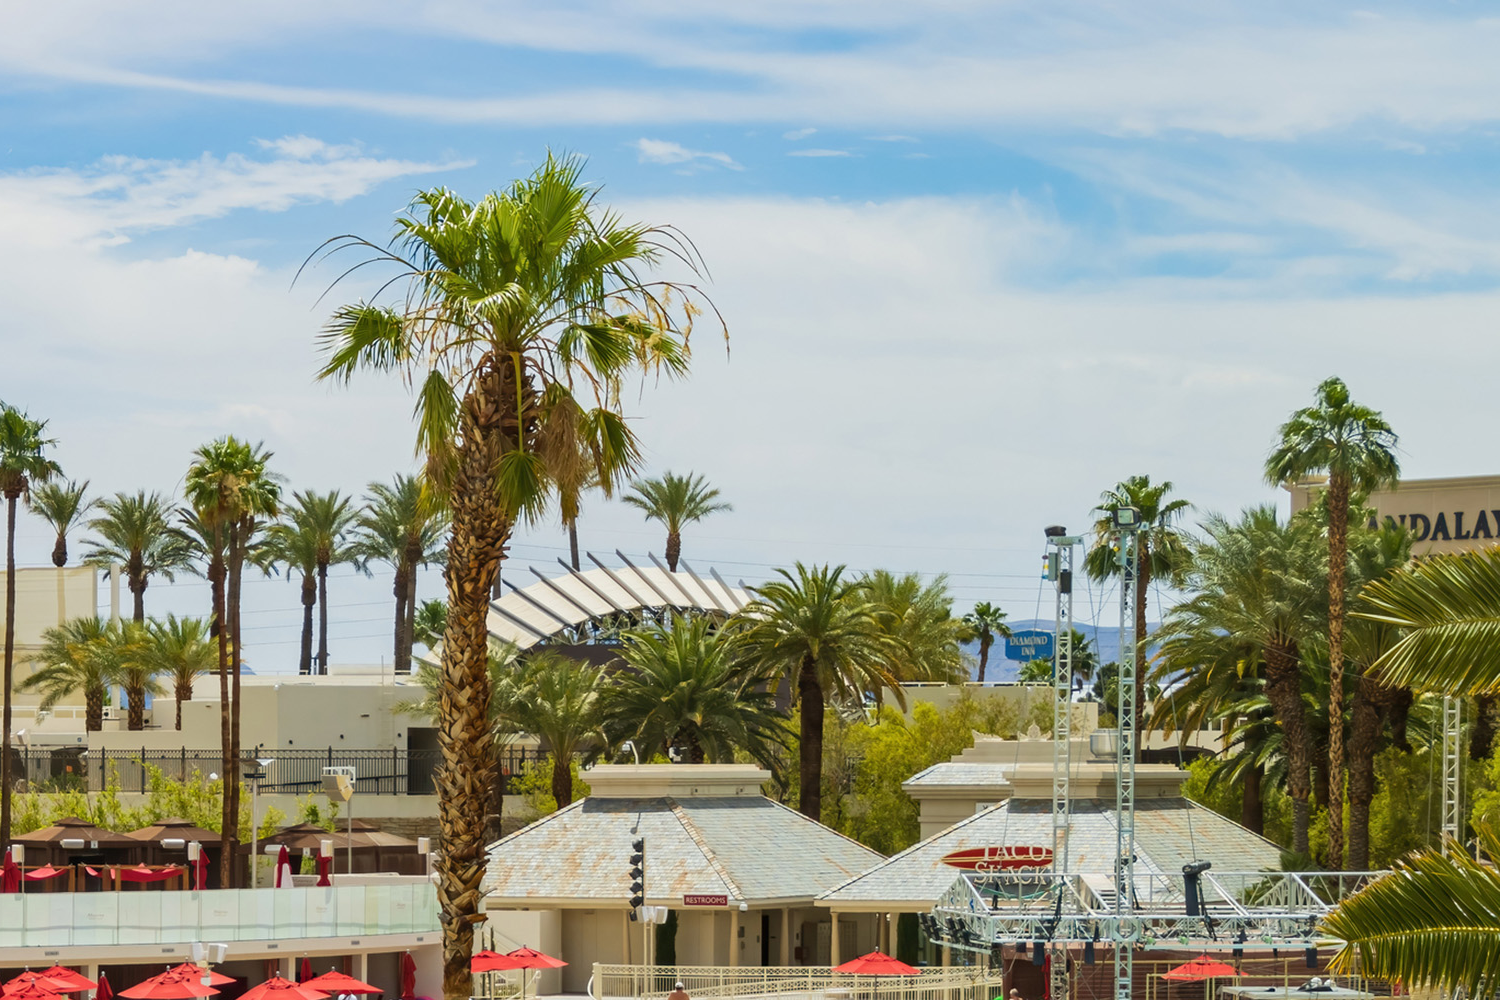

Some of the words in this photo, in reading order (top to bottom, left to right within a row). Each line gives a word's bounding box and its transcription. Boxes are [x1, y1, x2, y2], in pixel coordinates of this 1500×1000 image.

[1367, 510, 1500, 541] ANDALA
[1010, 636, 1048, 646] DIAMOND
[1021, 647, 1036, 656] INN
[981, 842, 1047, 862] TACO
[974, 861, 1048, 886] SHACK
[685, 896, 726, 904] RESTROOMS
